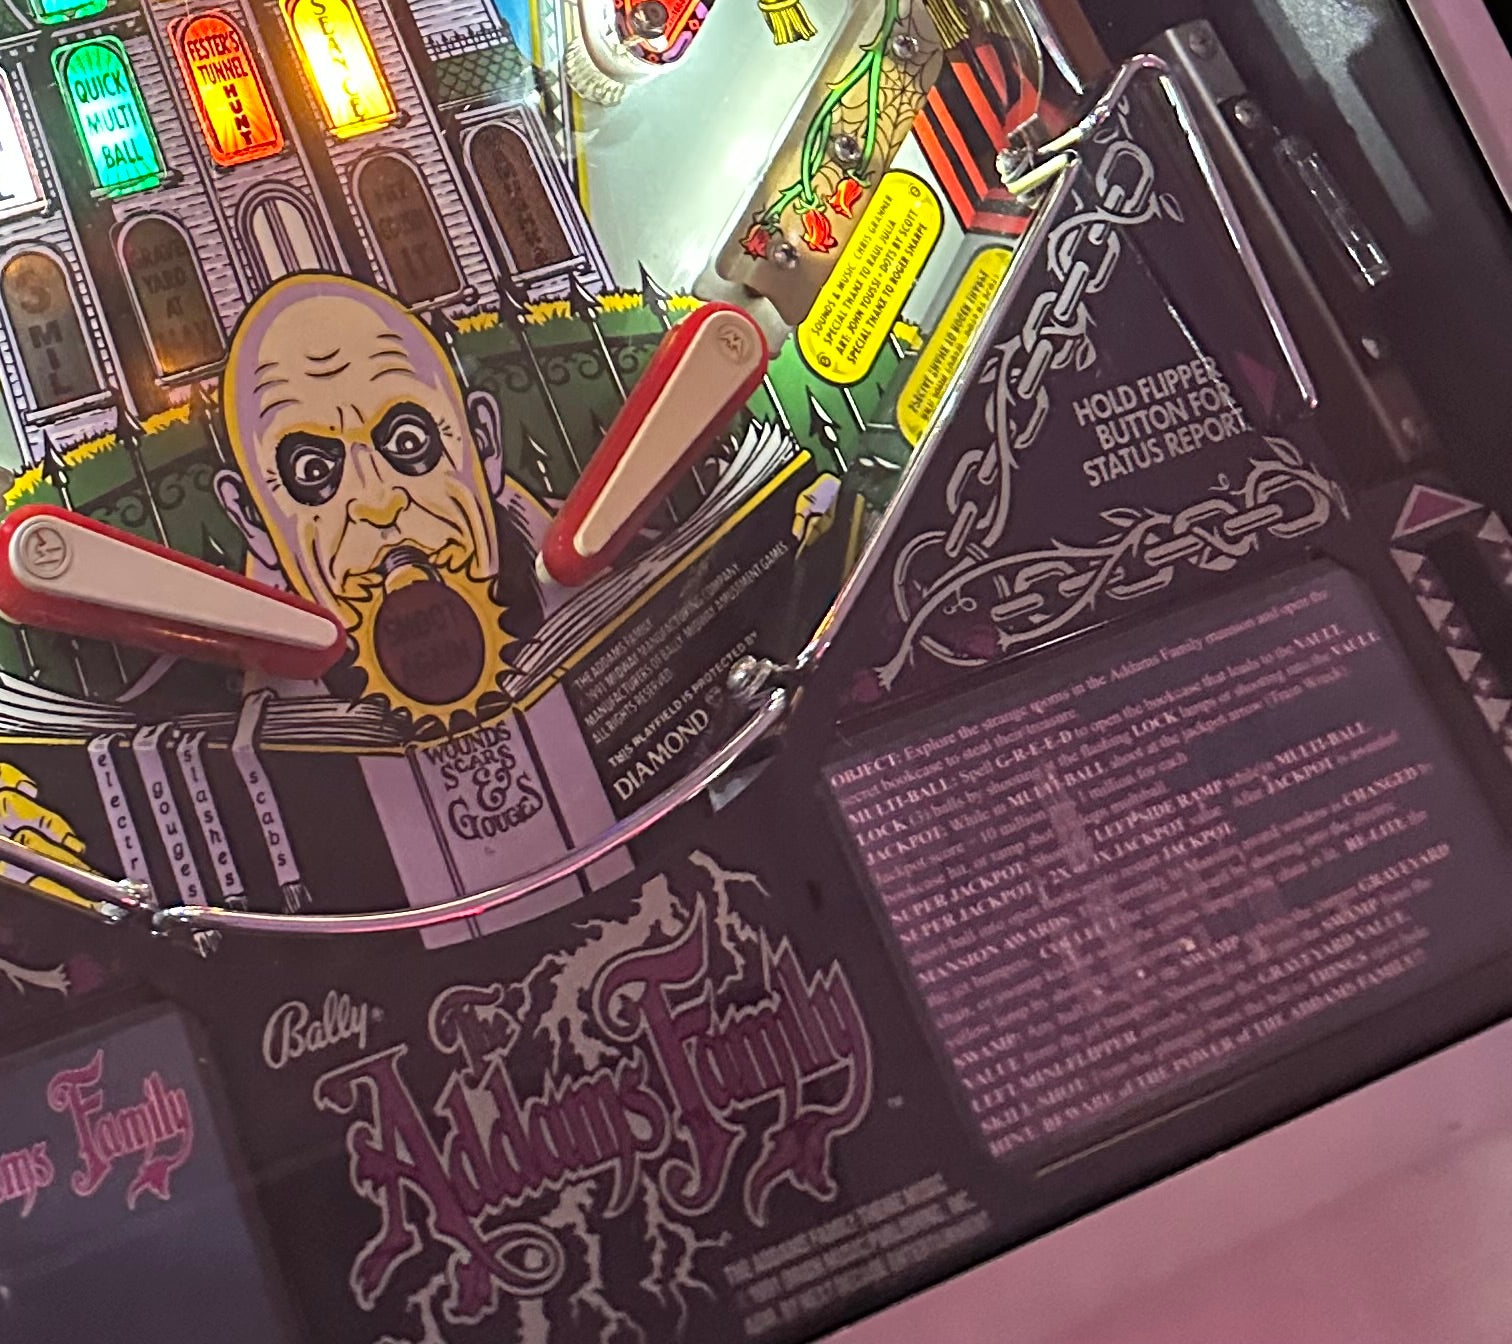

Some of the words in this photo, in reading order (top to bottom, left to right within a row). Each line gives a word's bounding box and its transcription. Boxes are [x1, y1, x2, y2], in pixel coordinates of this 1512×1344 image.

[188, 31, 241, 62] FESTER'S
[197, 57, 248, 85] TUNNEL
[74, 71, 128, 103] QUICK
[87, 104, 137, 133] MULTI
[223, 84, 253, 145] HUNT
[102, 142, 144, 169] BALL
[811, 299, 836, 335] SOUNDS
[853, 234, 872, 260] CHRIS
[823, 309, 848, 345] SPECIAL
[843, 280, 863, 309] THANX
[860, 267, 871, 278] TO
[867, 244, 883, 266] RAUL
[879, 219, 896, 243] JULIA
[845, 327, 871, 364] SPECIAL
[866, 297, 886, 327] THANX
[882, 284, 893, 297] TO
[889, 256, 909, 284] ROGER
[904, 222, 927, 255] SHARPE
[846, 309, 864, 333] JOHN
[860, 278, 881, 308] YOUSSI
[880, 249, 897, 272] DOTS
[892, 236, 904, 249] BY
[899, 208, 918, 235] SCOTT
[1073, 385, 1136, 426] HOLD
[1138, 356, 1222, 403] FLIPPER
[1096, 397, 1189, 450] BUTTON
[1189, 382, 1236, 417] FOR
[1083, 438, 1164, 488] STATUS
[584, 663, 653, 727] MANUFACTURERS
[758, 540, 789, 570] GAMES
[589, 641, 628, 678] ADDAMS
[591, 726, 610, 745] ALL
[605, 699, 637, 731] RIGHTS
[633, 667, 674, 707] RESERVED
[609, 743, 634, 768] THIS
[630, 699, 682, 748] PLAYFIELD
[679, 689, 692, 702] IS
[690, 641, 747, 694] PROTECTED
[744, 630, 759, 646] BY
[423, 723, 511, 767] WOUNDS
[443, 745, 517, 792] SCARS
[612, 706, 712, 800] DIAMOND
[829, 750, 902, 789] OBJECT:
[956, 720, 979, 740] the
[854, 814, 906, 847] LOCK
[1130, 708, 1178, 738] LOCK
[993, 727, 1073, 770] G-R-E-E-D
[182, 747, 236, 888] slashes
[249, 769, 288, 869] scabs
[472, 769, 511, 810] &
[152, 781, 199, 900] gouges
[262, 990, 370, 1072] Bally
[428, 984, 521, 1074] The
[47, 1048, 196, 1212] Family
[314, 1044, 670, 1325] Addams
[594, 891, 874, 1227] Family
